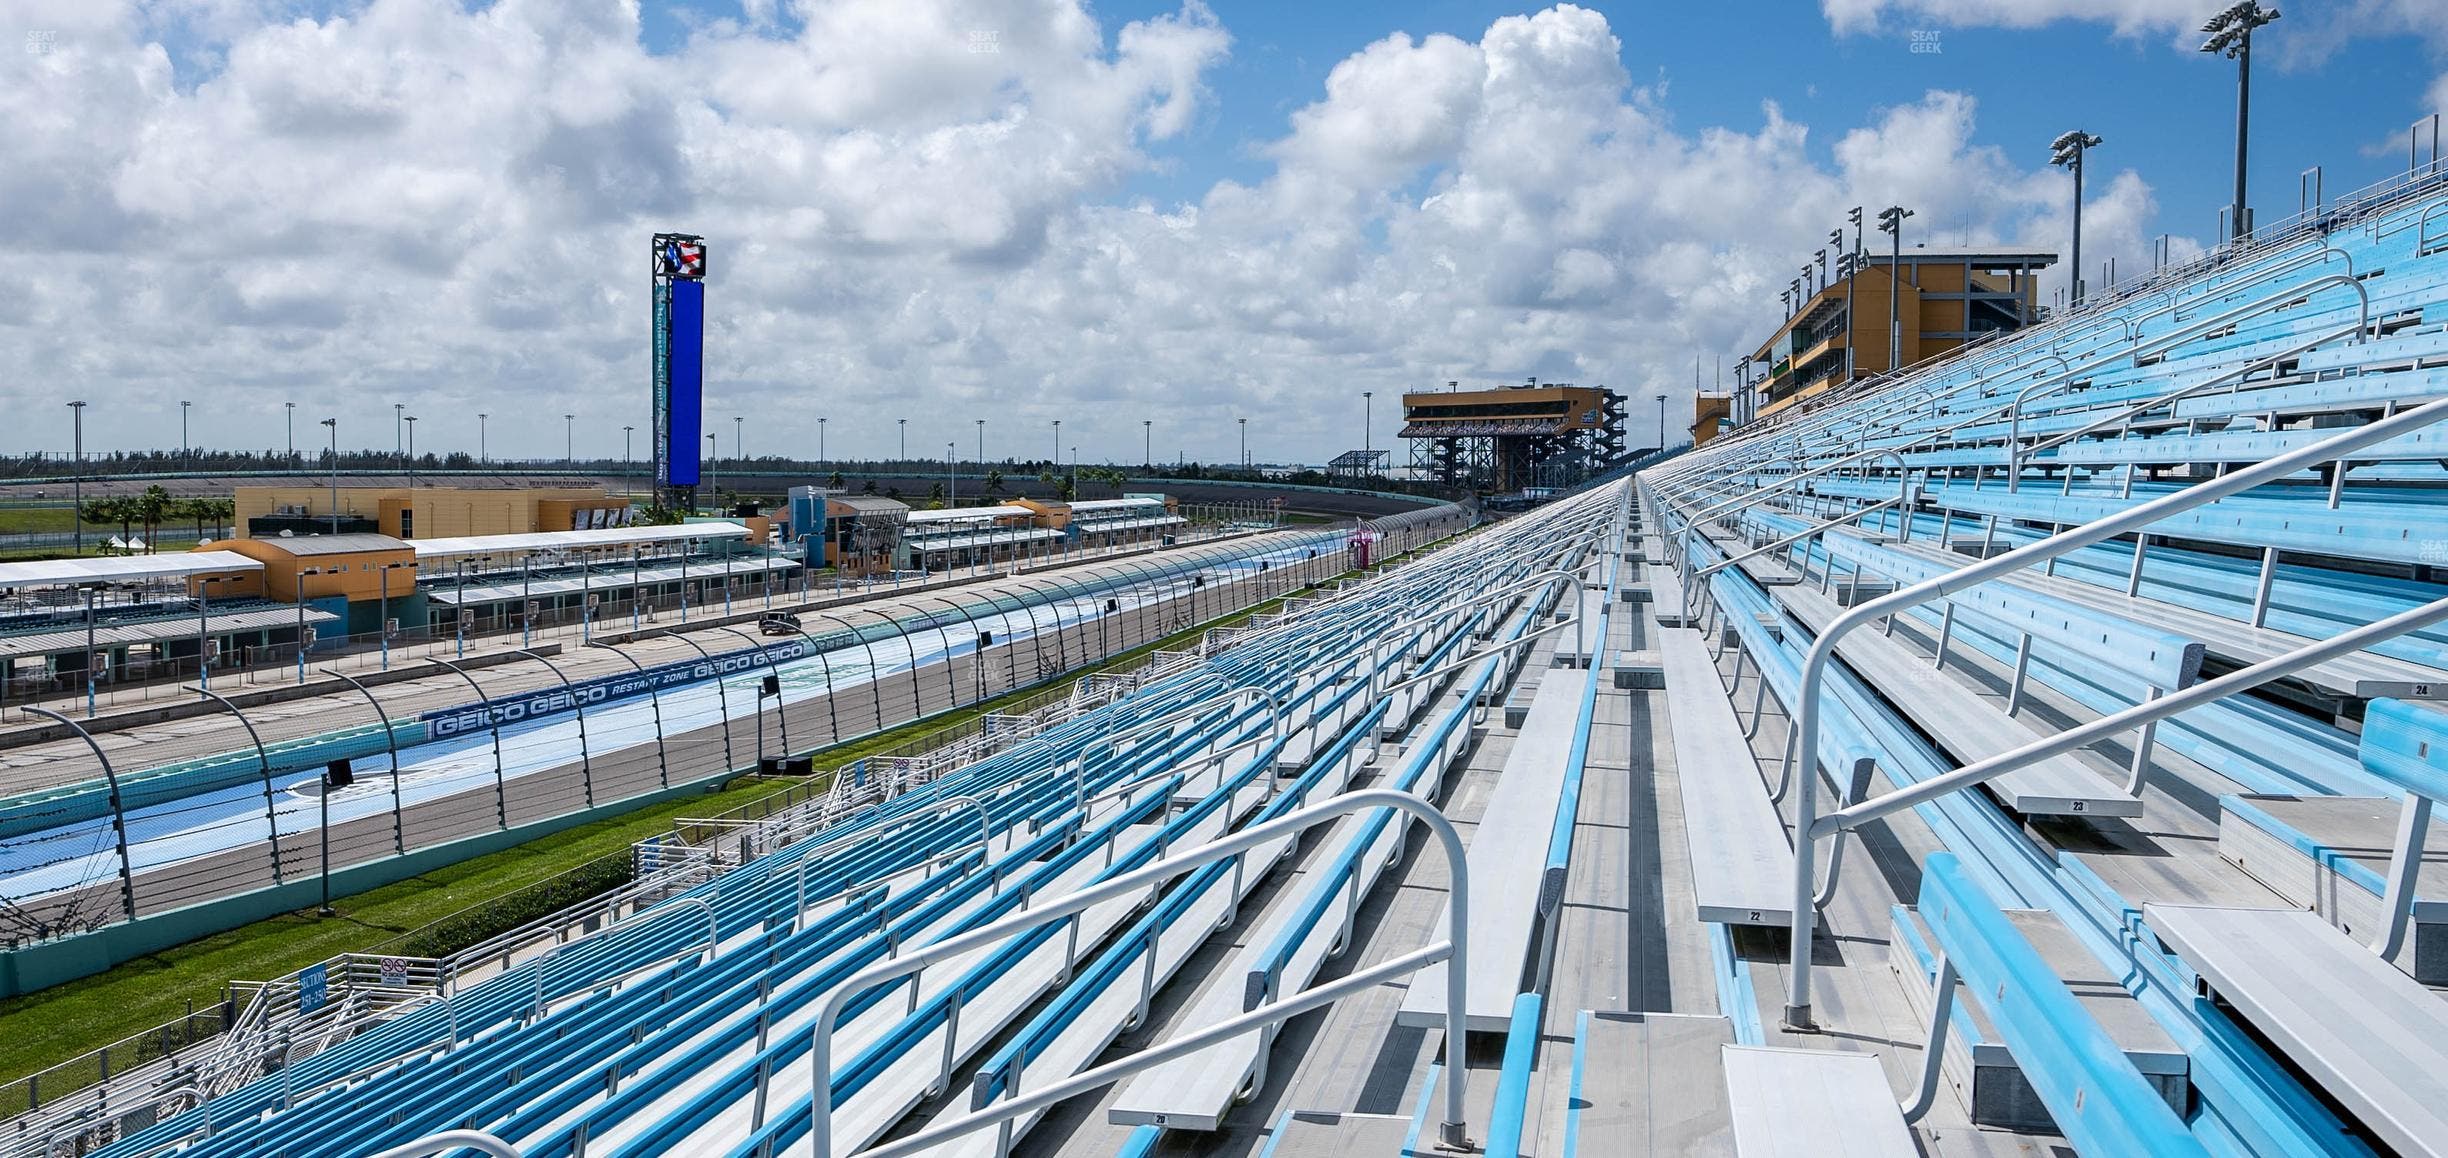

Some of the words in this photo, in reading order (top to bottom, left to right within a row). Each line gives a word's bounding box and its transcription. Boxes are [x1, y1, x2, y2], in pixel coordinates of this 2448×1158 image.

[436, 704, 525, 735] GEICO
[529, 686, 606, 715] GEICO
[662, 670, 690, 684] ZONE
[694, 655, 749, 679] GEICO
[753, 644, 803, 665] GEICO
[2416, 685, 2427, 695] 24
[2073, 801, 2084, 811] 23
[1750, 911, 1761, 921] 22
[301, 970, 327, 989] SECTIONS
[1156, 1114, 1166, 1124] 20
